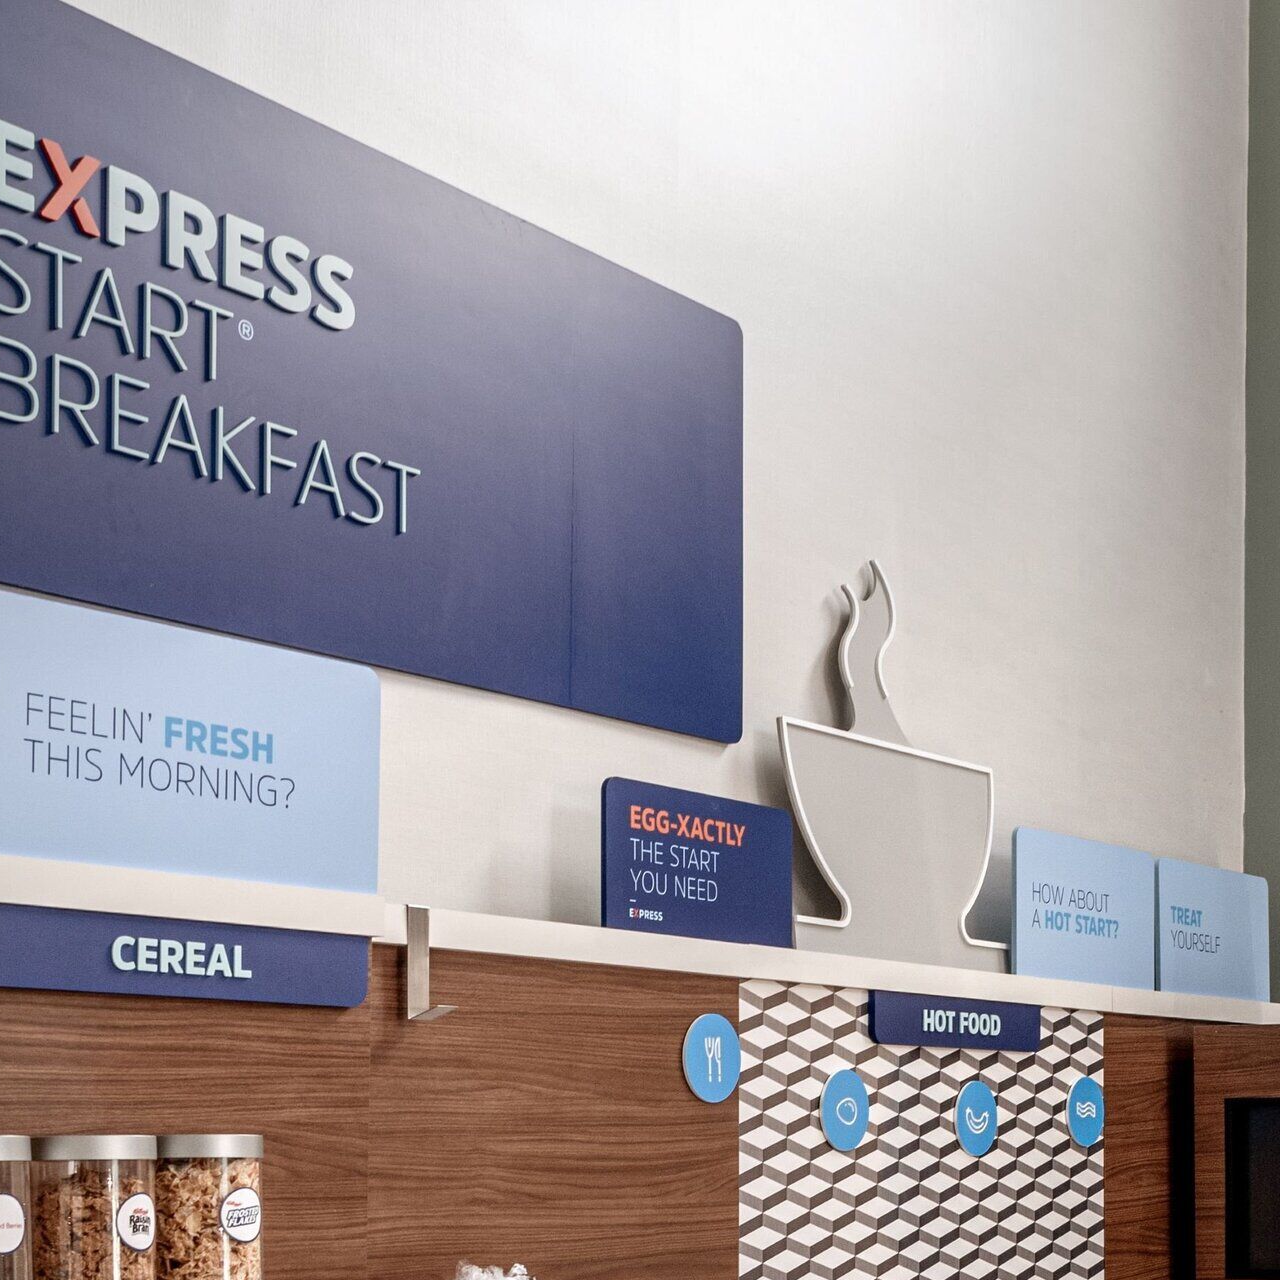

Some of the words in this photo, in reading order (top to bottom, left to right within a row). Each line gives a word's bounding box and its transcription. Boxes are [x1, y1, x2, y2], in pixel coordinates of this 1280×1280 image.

[163, 715, 275, 765] FRESH
[22, 738, 104, 783] THIS
[118, 751, 297, 809] MORNING?
[629, 804, 746, 847] EGG-XACTLY
[629, 837, 664, 866] THE
[669, 843, 721, 874] START
[629, 868, 668, 896] YOU
[673, 874, 719, 903] NEED
[1031, 881, 1064, 906] HOW
[1068, 887, 1110, 914] ABOUT
[629, 907, 664, 922] EXPRESS
[1031, 908, 1041, 929] A
[1044, 909, 1071, 931] HOT
[1074, 913, 1120, 939] START?
[1169, 905, 1203, 928] TREAT
[111, 934, 253, 979] CEREAL
[1169, 928, 1221, 954] YOURSELF
[922, 1008, 956, 1033] HOT
[959, 1011, 1002, 1036] FOOD
